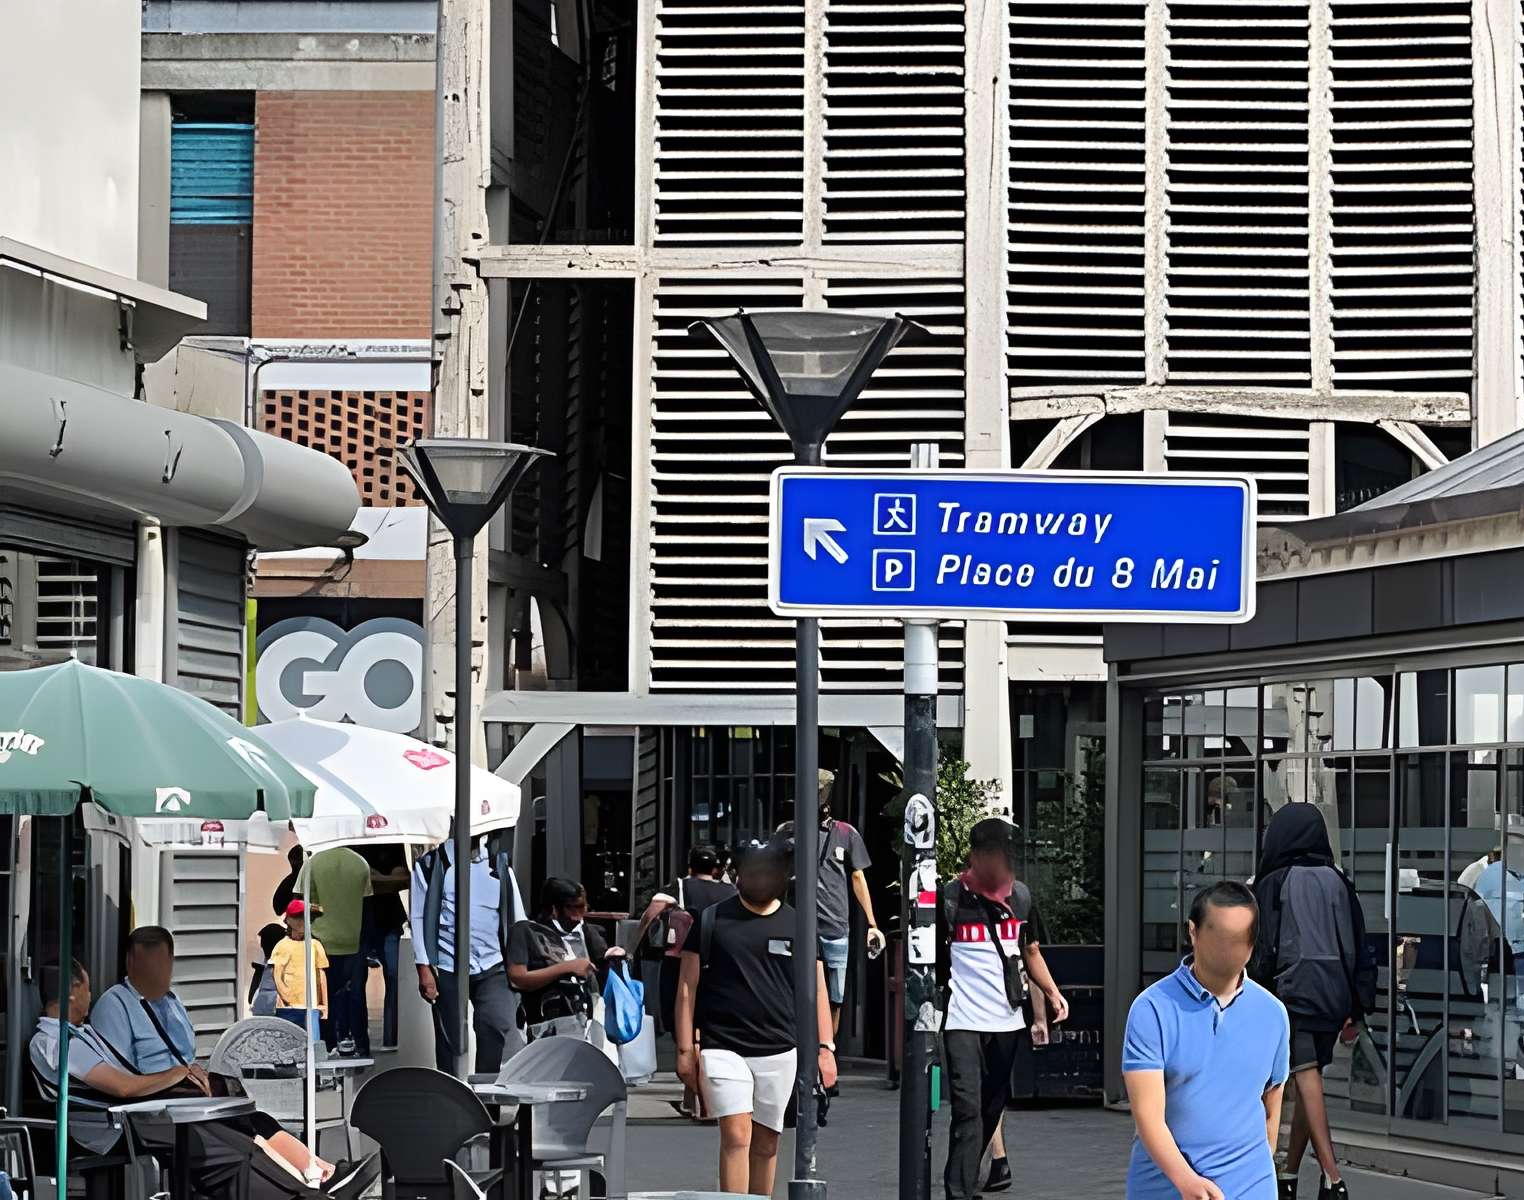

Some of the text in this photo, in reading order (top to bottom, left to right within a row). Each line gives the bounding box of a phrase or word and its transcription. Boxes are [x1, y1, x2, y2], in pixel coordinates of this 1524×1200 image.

[938, 502, 1113, 544] Tramway
[884, 558, 904, 583] P
[936, 554, 1222, 590] Place du 8 Mai
